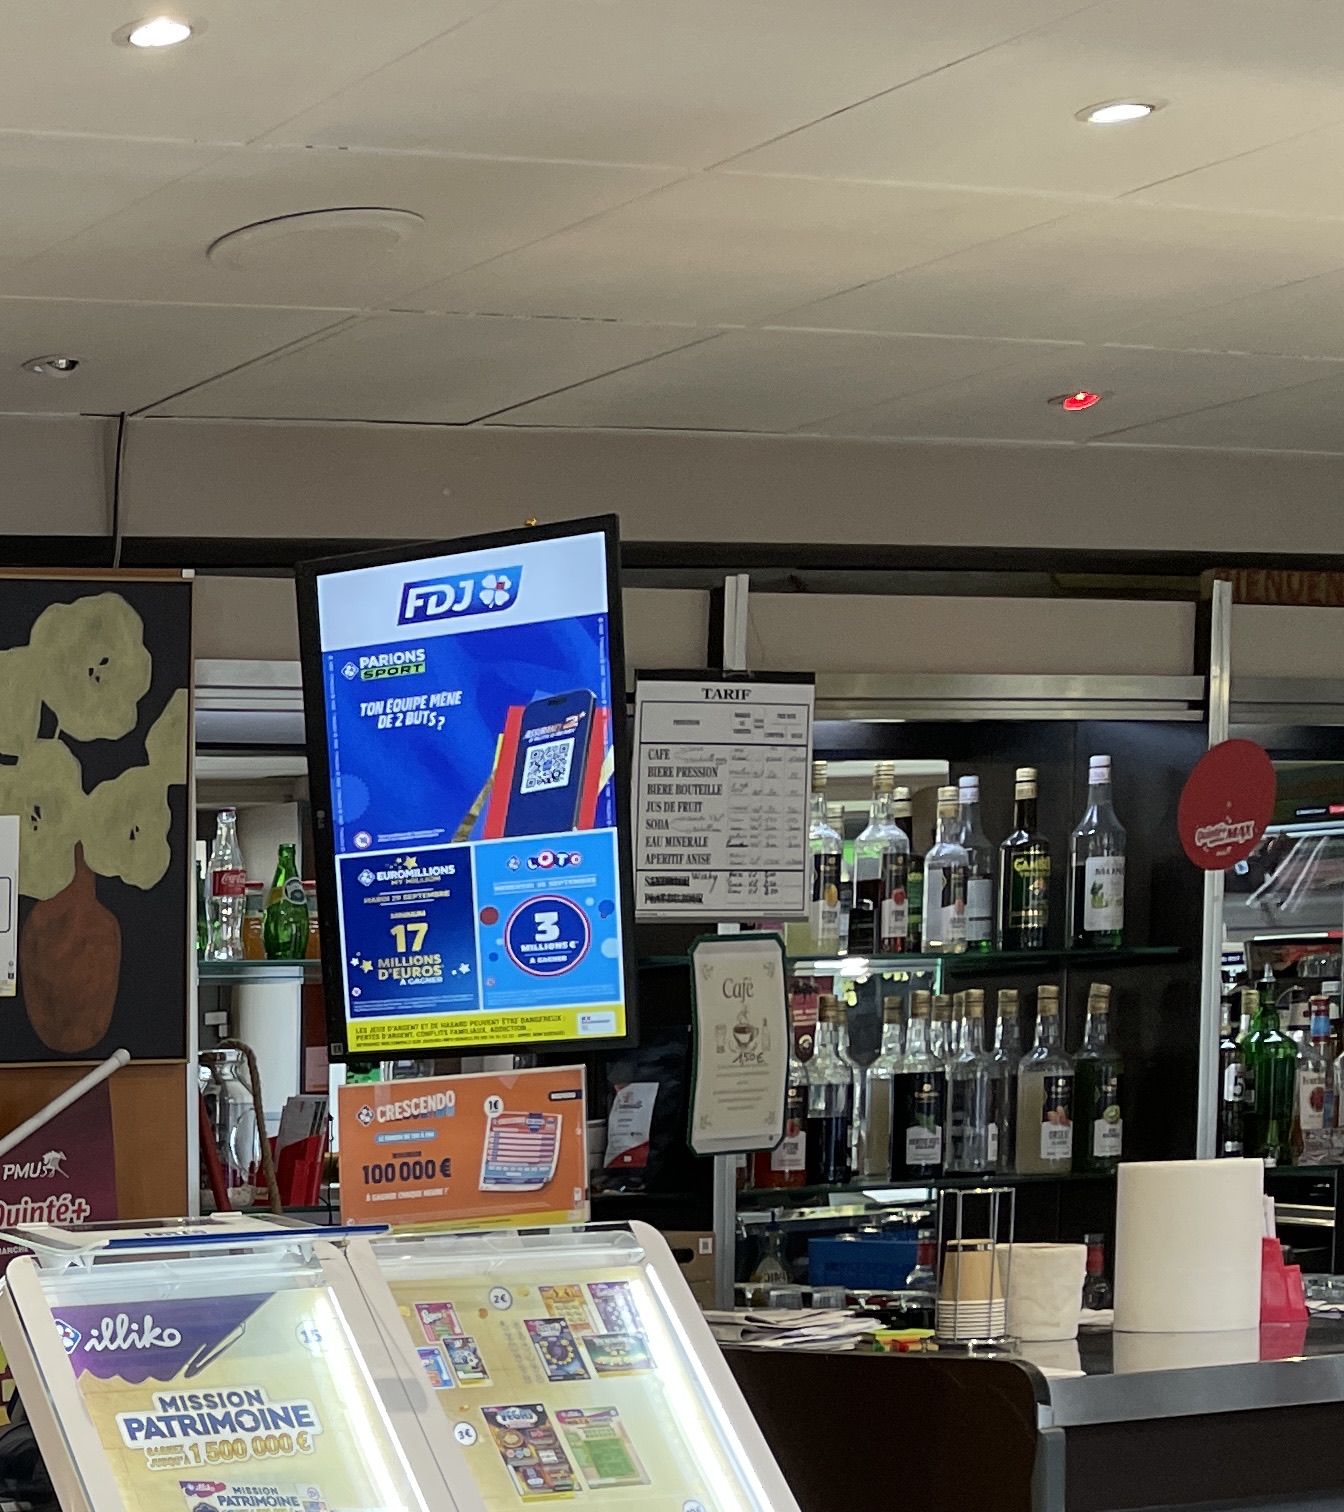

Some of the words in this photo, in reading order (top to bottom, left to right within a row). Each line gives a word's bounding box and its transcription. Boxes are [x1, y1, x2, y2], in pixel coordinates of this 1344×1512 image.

[404, 578, 474, 620] FDJ
[359, 648, 426, 669] PARIONS
[363, 663, 424, 680] SPORT
[701, 687, 752, 700] TARIF
[377, 713, 393, 729] DE
[395, 712, 403, 727] 2
[405, 710, 437, 727] BUTS
[647, 765, 674, 778] BIERE
[675, 765, 719, 778] PRESSION
[647, 783, 674, 796] BIERE
[675, 783, 723, 796] BOUTEILLE
[645, 801, 662, 813] JUS
[663, 801, 676, 813] DE
[677, 801, 703, 813] FRUIT
[645, 836, 663, 848] EAU
[664, 836, 709, 848] MINERALE
[526, 849, 583, 870] LOTO
[644, 853, 684, 866] APERITIF
[685, 853, 712, 866] ANISE
[376, 864, 456, 882] EUROMILLIONS
[534, 911, 560, 942] 3
[390, 922, 429, 954] 17
[722, 976, 754, 1002] Café
[376, 1090, 456, 1124] CRESCENDO
[362, 1162, 396, 1185] 100
[398, 1160, 437, 1182] 000
[440, 1157, 452, 1178] €
[83, 1314, 182, 1352] illiko
[158, 1388, 266, 1414] MISSION
[123, 1403, 316, 1443] PATRIMOINE
[217, 1494, 301, 1508] PATRIMOINE
[232, 1486, 279, 1496] MISSION
